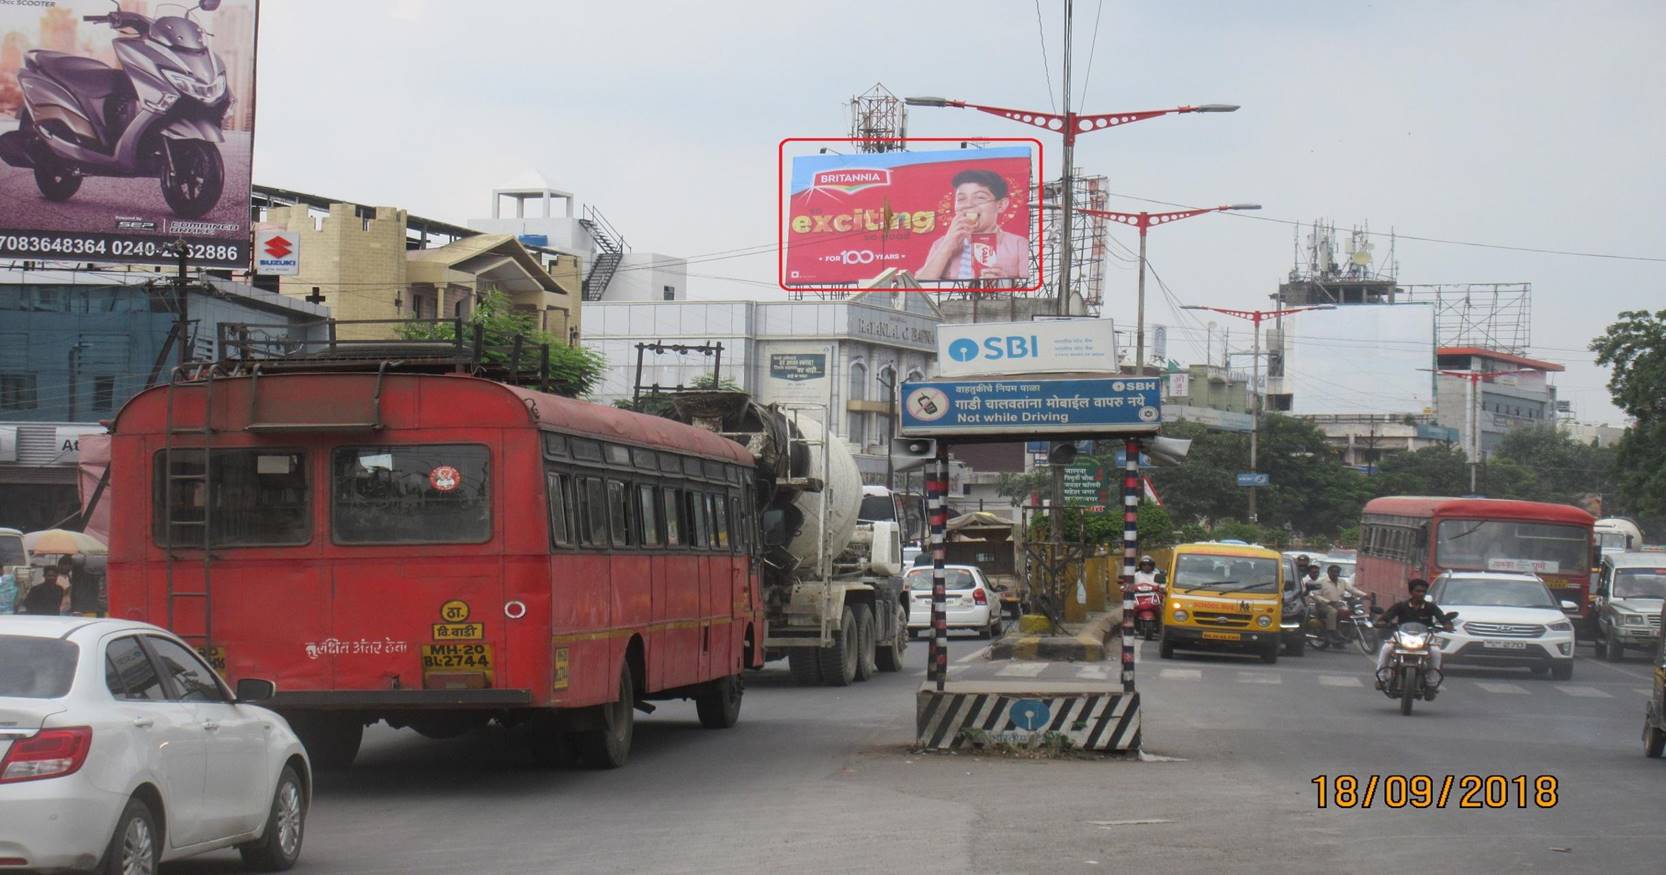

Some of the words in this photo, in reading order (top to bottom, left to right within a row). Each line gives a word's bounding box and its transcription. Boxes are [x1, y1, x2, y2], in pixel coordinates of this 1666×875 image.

[820, 173, 881, 184] BRITANNIA
[170, 221, 240, 232] COMBINED
[791, 208, 936, 234] exciting
[0, 235, 107, 255] 7083648364
[259, 259, 297, 267] SUZUKI
[840, 249, 874, 265] 100
[983, 335, 1039, 361] SBI
[955, 384, 992, 396] वाहतुकीचे
[995, 383, 1017, 393] नियम
[1126, 381, 1156, 392] SBH
[955, 395, 981, 411] गाडी
[985, 395, 1042, 410] चालवतांना
[1046, 394, 1090, 410] मोबाईल
[1128, 393, 1146, 408] नये
[957, 412, 981, 424] Not
[985, 411, 1018, 423] while
[1021, 410, 1069, 424] Driving
